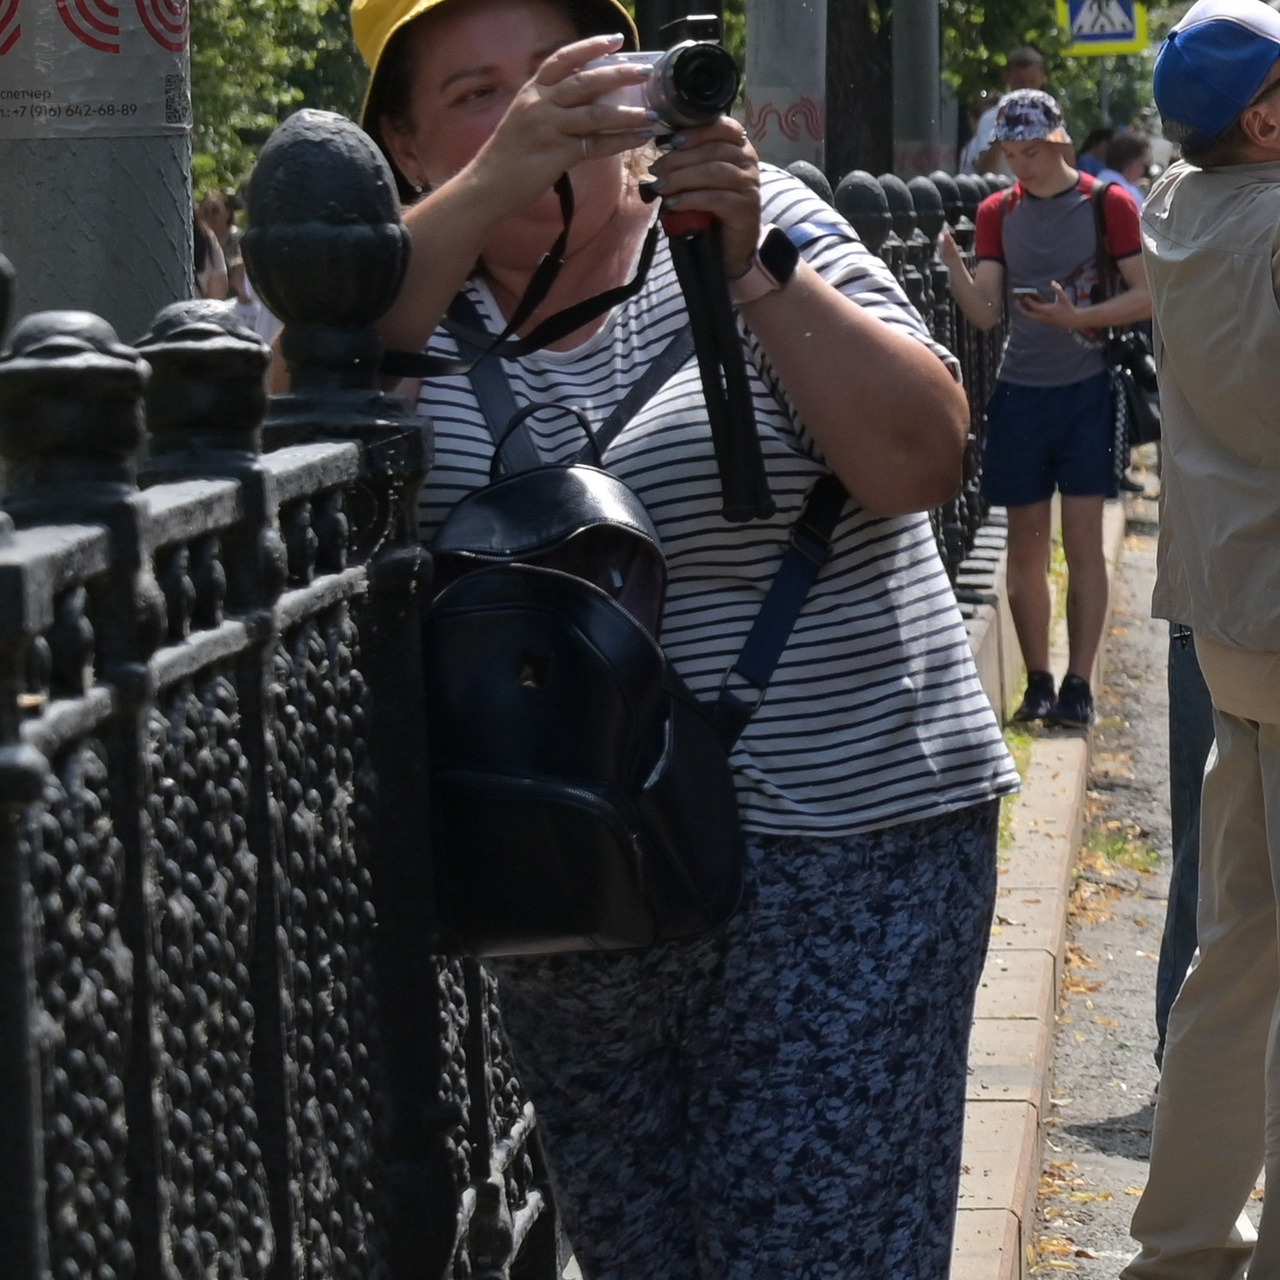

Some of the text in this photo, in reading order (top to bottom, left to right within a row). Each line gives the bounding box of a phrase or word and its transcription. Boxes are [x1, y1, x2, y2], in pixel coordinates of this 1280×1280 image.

[14, 105, 27, 117] +7
[30, 104, 61, 118] (916)
[65, 103, 138, 117] 642-68-89
